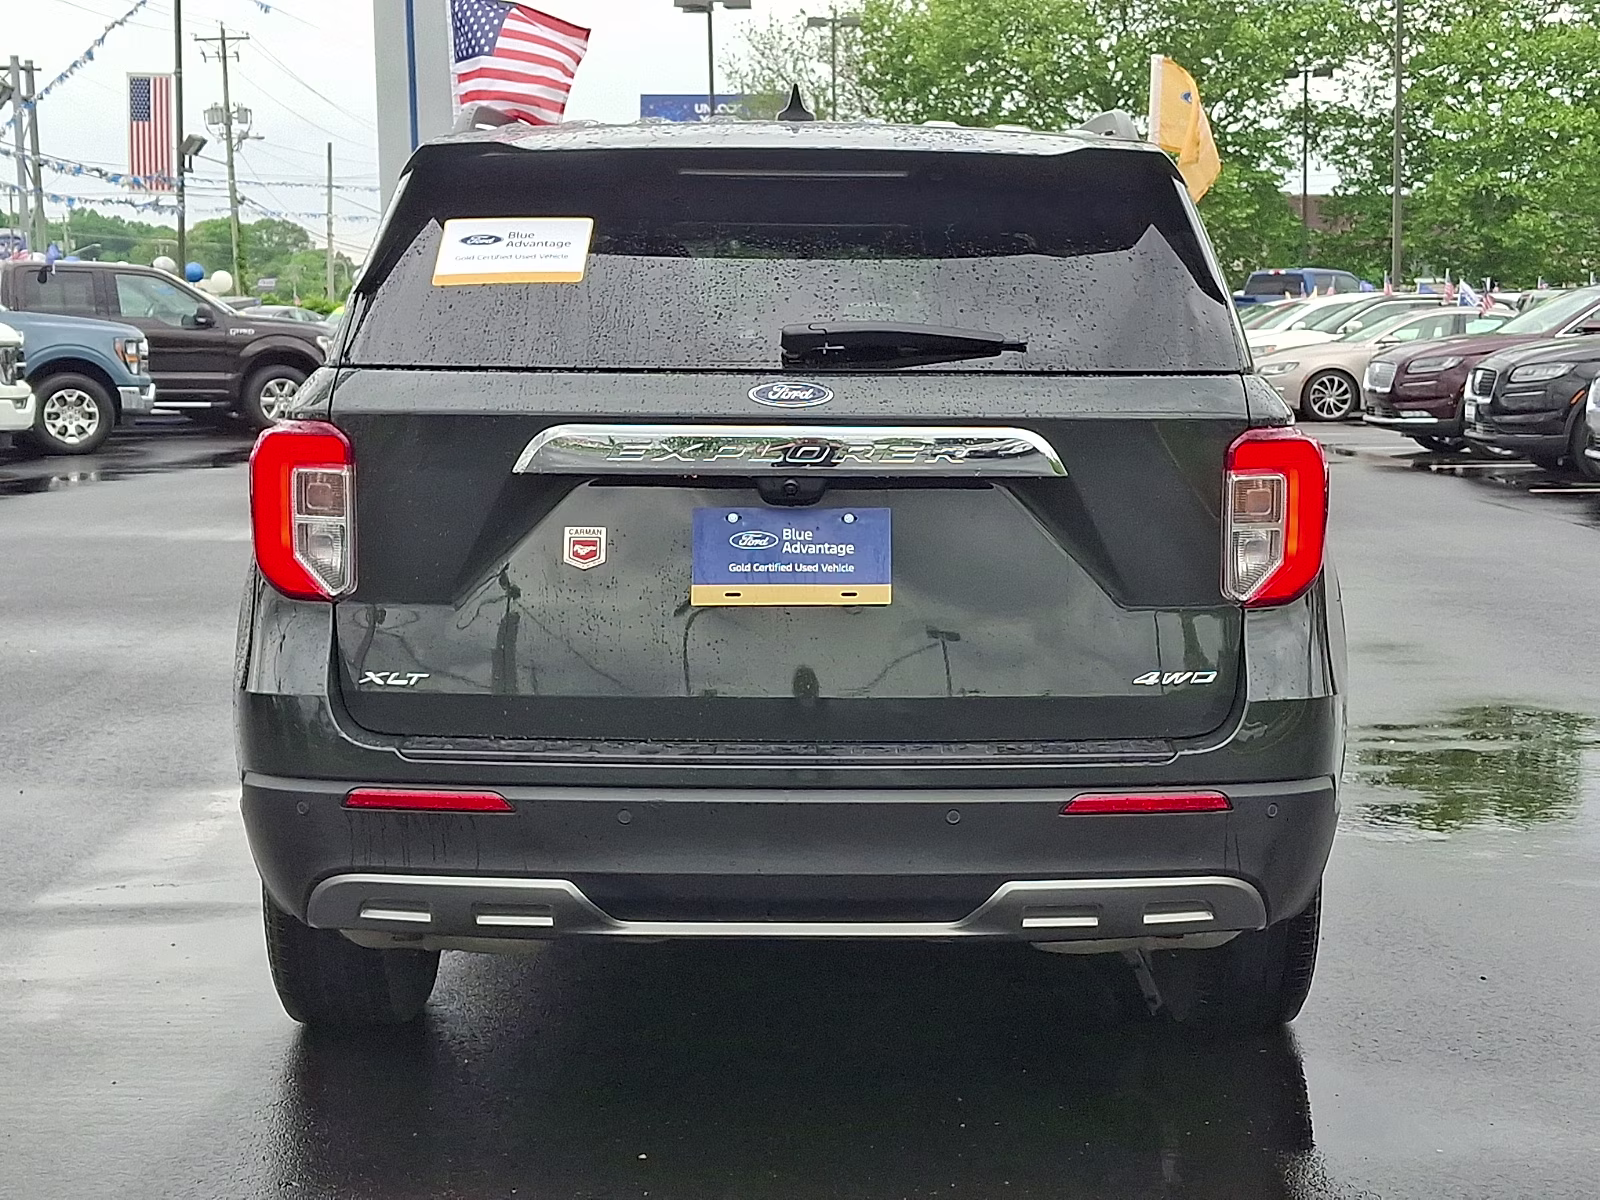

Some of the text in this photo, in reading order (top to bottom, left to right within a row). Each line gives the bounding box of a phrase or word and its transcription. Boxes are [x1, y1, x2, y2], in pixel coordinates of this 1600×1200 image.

[694, 103, 743, 114] UNOCK
[508, 231, 535, 239] Blue
[505, 240, 572, 249] Advantage
[477, 253, 513, 261] Certified
[768, 384, 814, 400] Ford
[606, 442, 967, 464] EXPLORER
[738, 533, 770, 546] Ford
[782, 528, 813, 541] Blue
[782, 541, 855, 557] Advantage
[728, 562, 855, 573] Gold Certified Used Vehicle
[358, 671, 430, 686] XLT
[1132, 670, 1218, 686] 4WD
